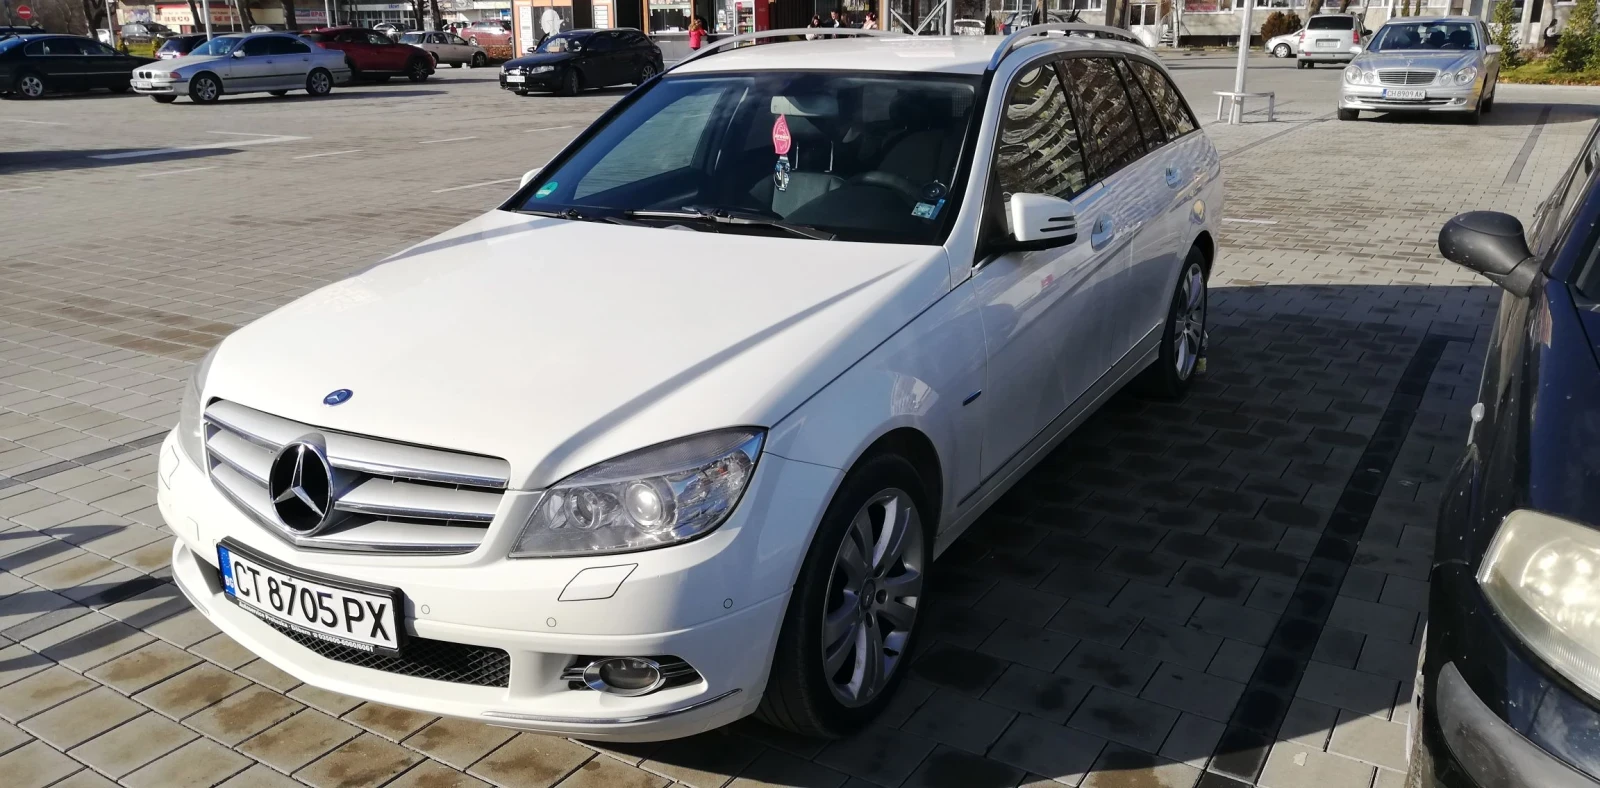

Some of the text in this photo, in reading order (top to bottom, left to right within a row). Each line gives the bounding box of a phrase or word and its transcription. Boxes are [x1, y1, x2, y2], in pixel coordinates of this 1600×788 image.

[1397, 90, 1414, 98] 8909
[234, 561, 391, 642] CT 8705 PX
